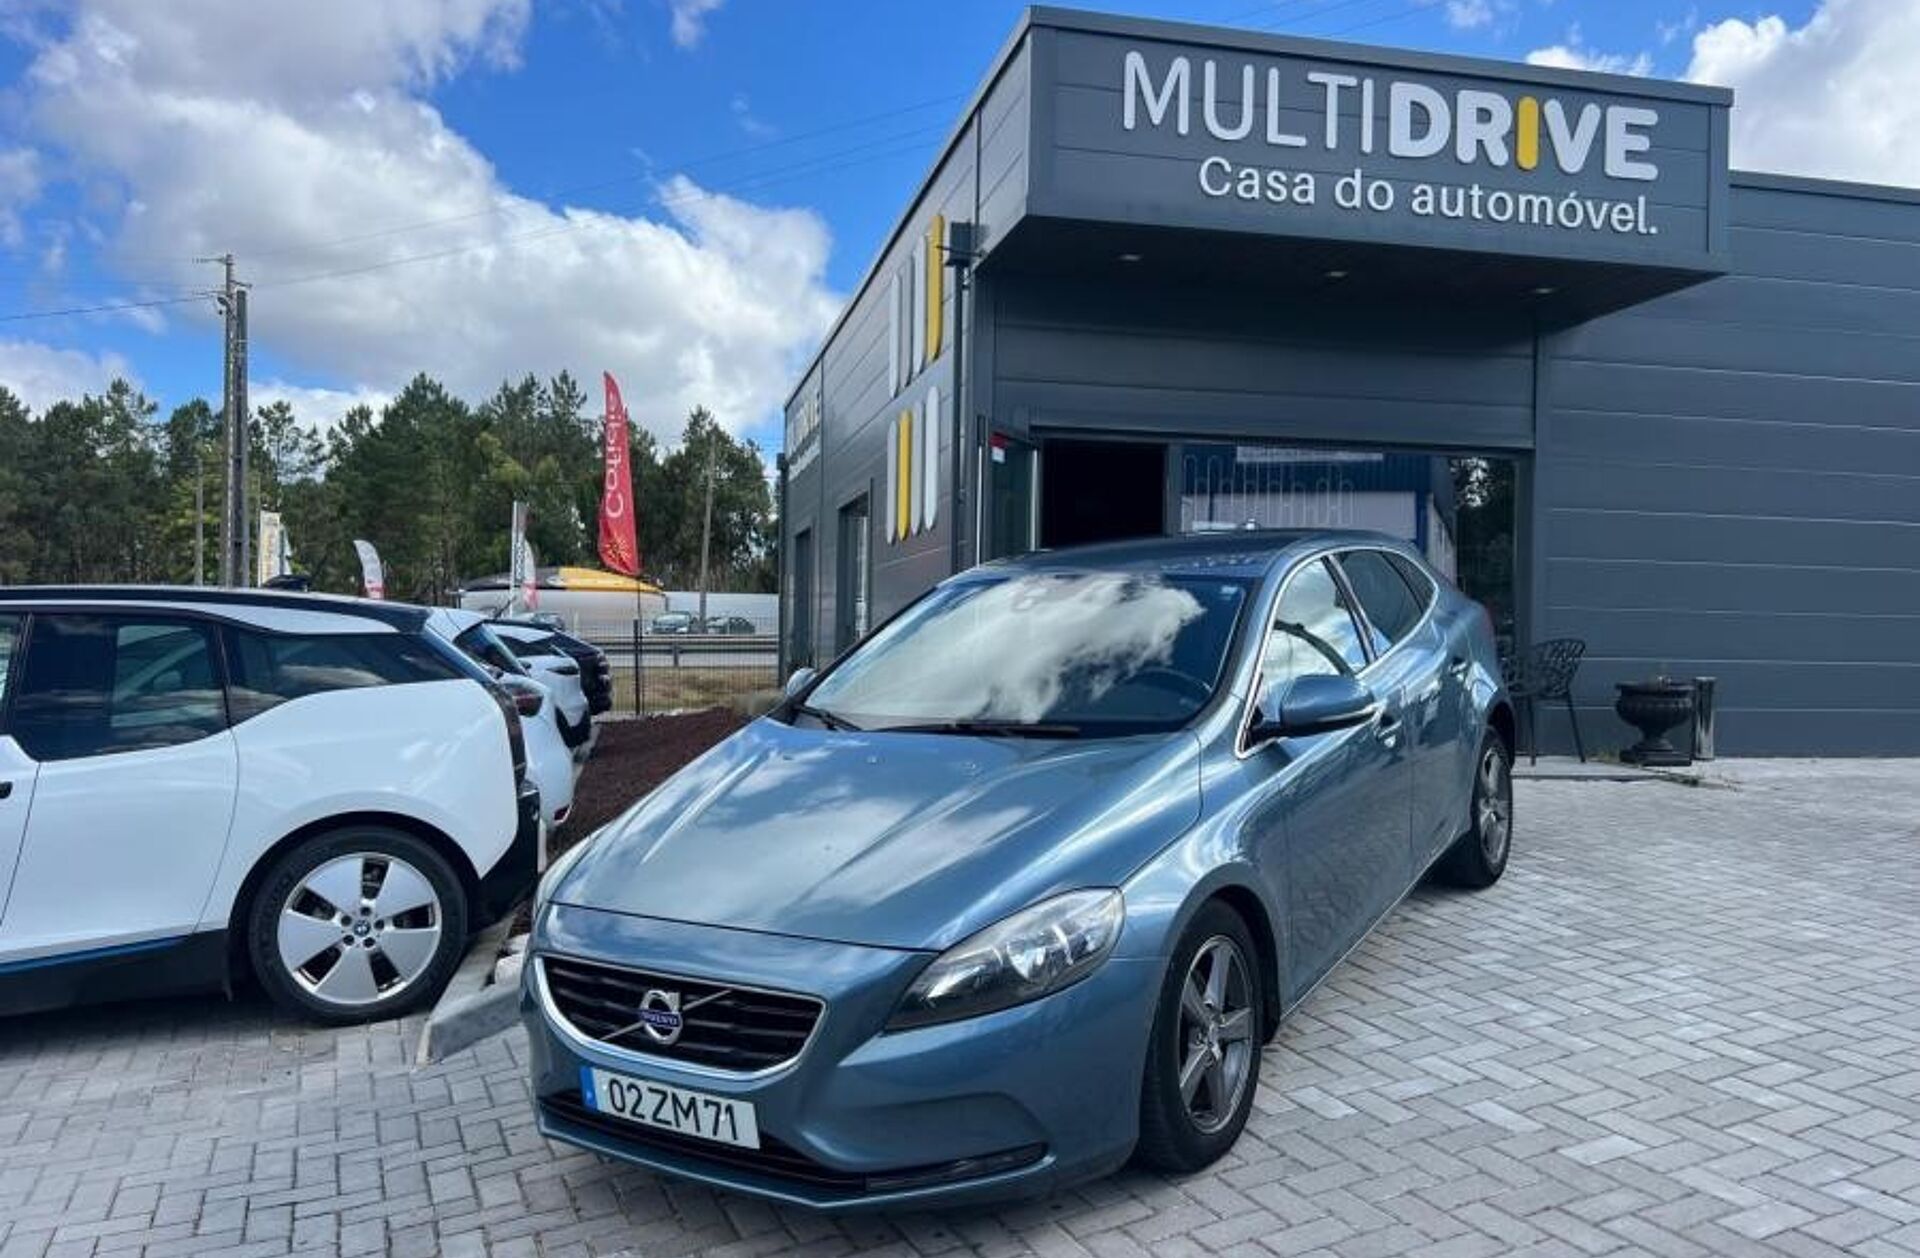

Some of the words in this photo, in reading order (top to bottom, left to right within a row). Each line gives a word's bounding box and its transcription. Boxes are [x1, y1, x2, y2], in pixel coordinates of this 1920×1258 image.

[1123, 51, 1658, 181] MULTIDRIVE
[1199, 156, 1316, 205] Casa
[1334, 168, 1394, 211] do
[1410, 183, 1658, 234] automóvel.
